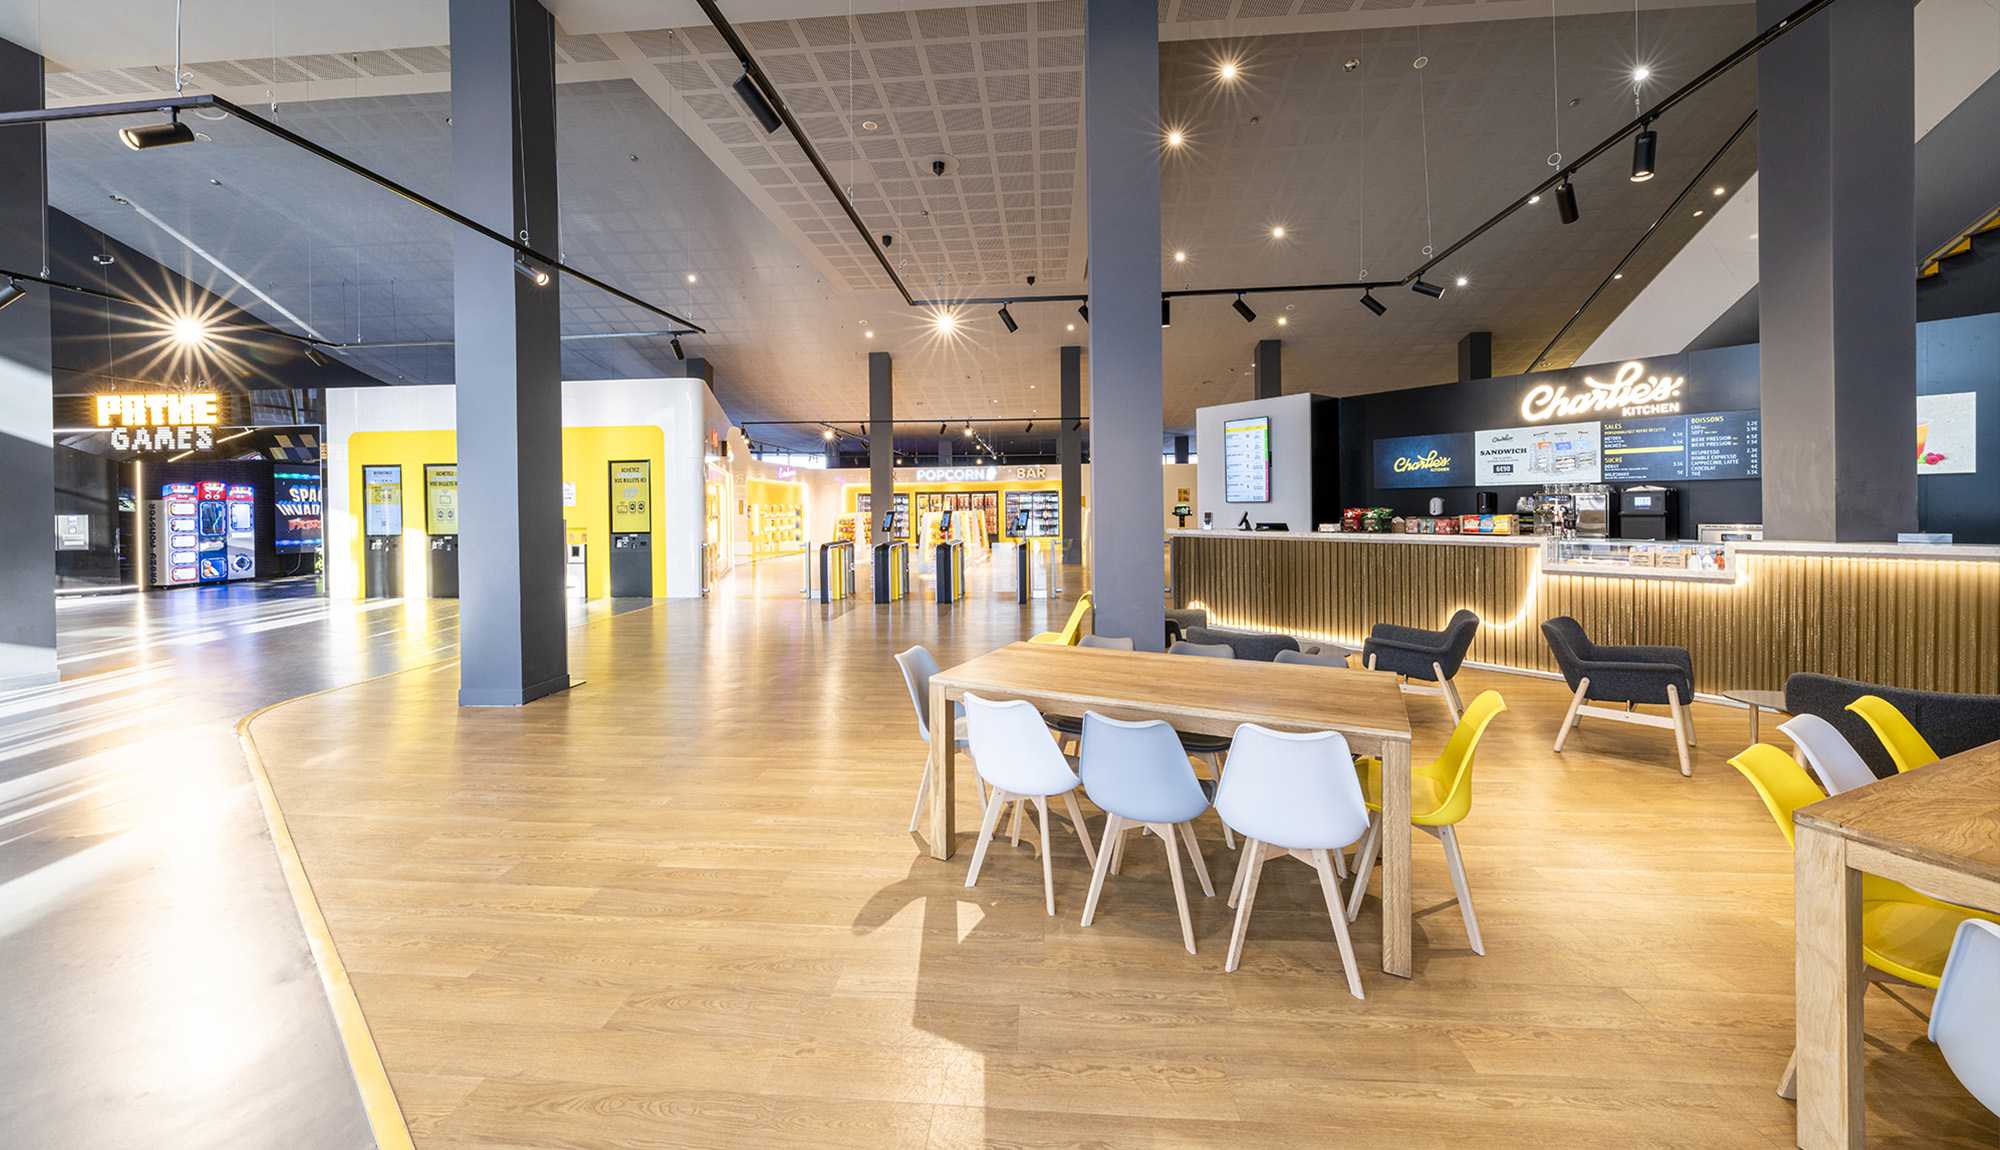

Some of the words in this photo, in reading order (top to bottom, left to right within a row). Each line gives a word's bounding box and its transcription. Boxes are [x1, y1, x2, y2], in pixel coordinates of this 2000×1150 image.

[1622, 402, 1680, 416] KITCHEN
[111, 427, 213, 450] GAMES
[1480, 447, 1528, 456] SANDWICH
[916, 468, 985, 481] POPCORN
[1016, 467, 1046, 479] BAR
